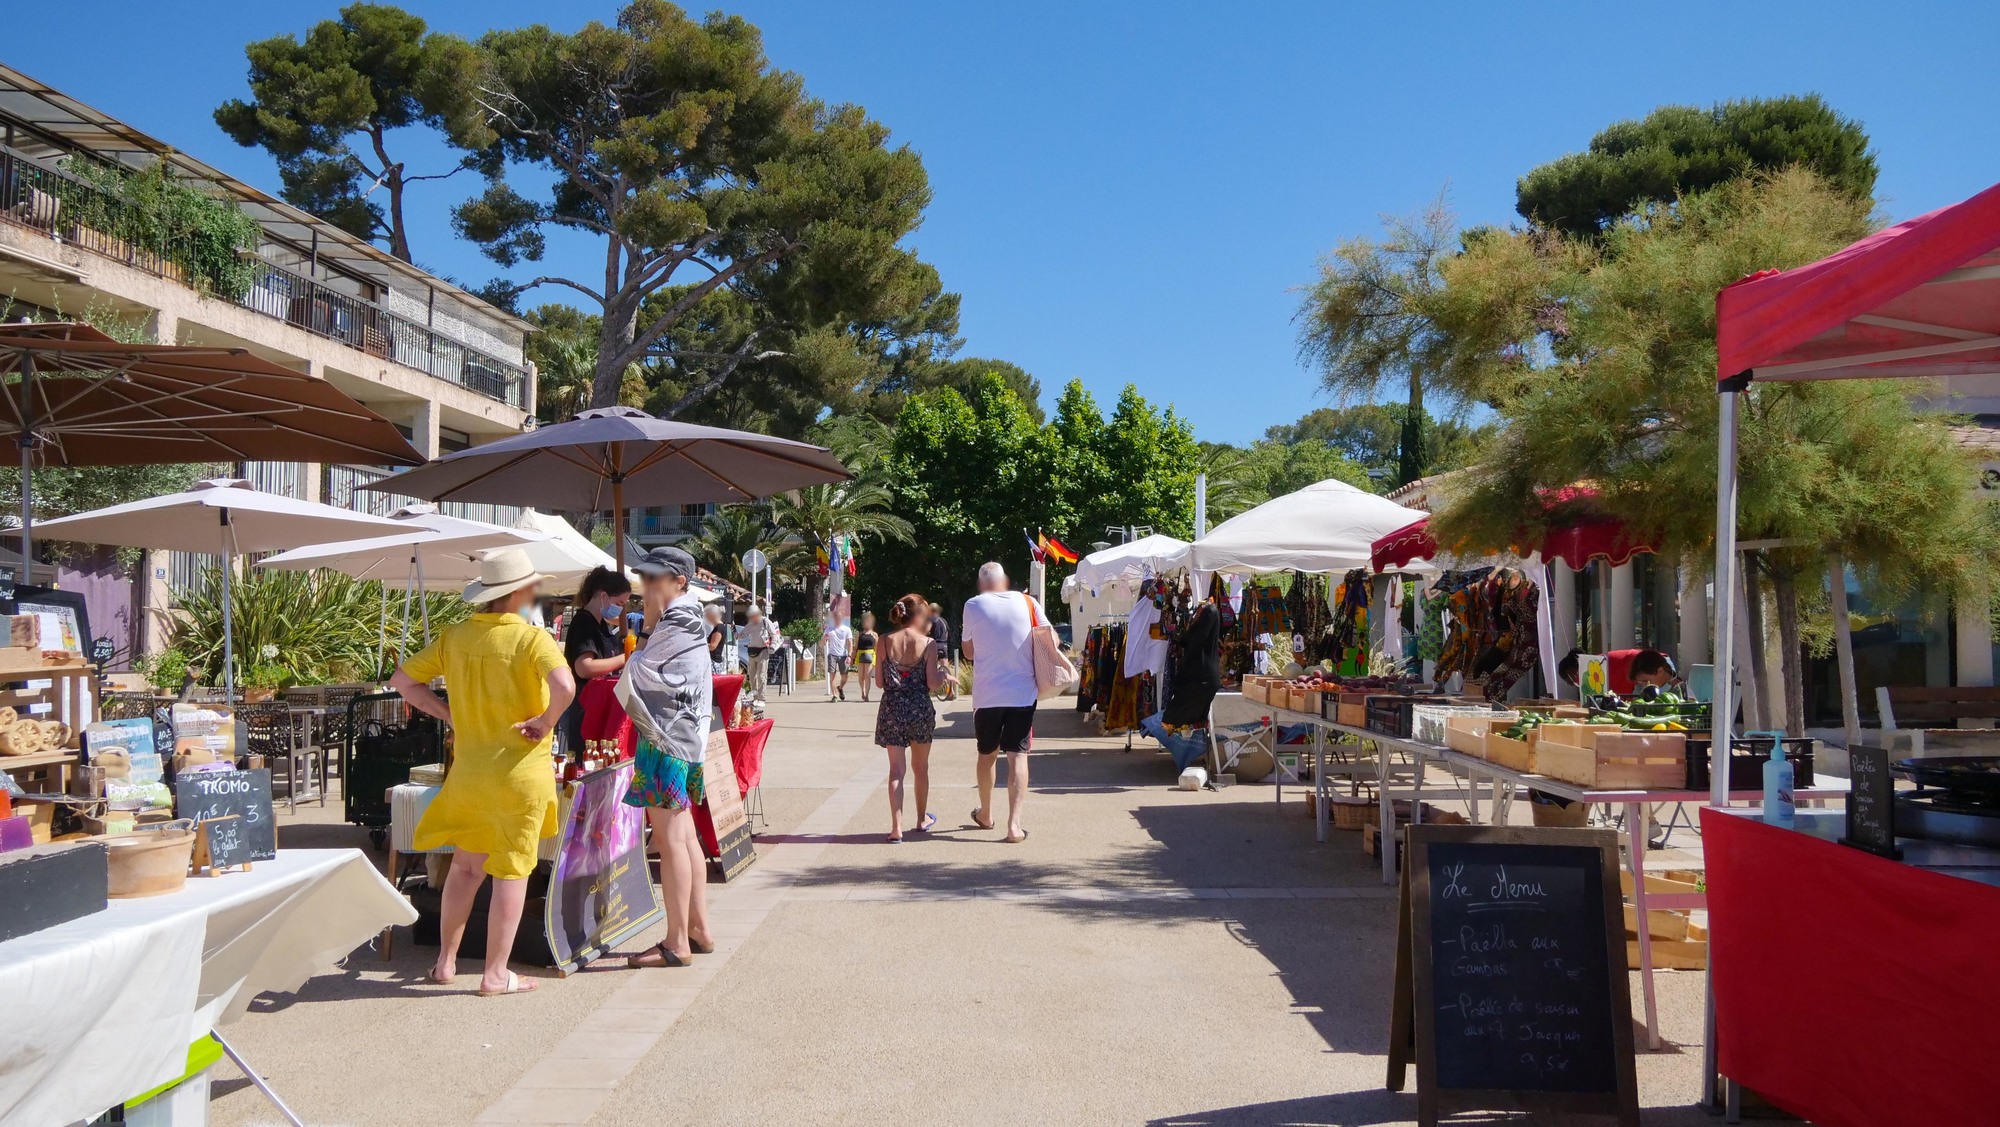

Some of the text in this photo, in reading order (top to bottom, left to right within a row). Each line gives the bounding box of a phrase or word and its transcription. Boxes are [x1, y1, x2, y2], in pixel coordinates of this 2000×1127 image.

[246, 805, 259, 823] 3
[1443, 861, 1548, 899] Le Menu
[1532, 937, 1560, 950] aux
